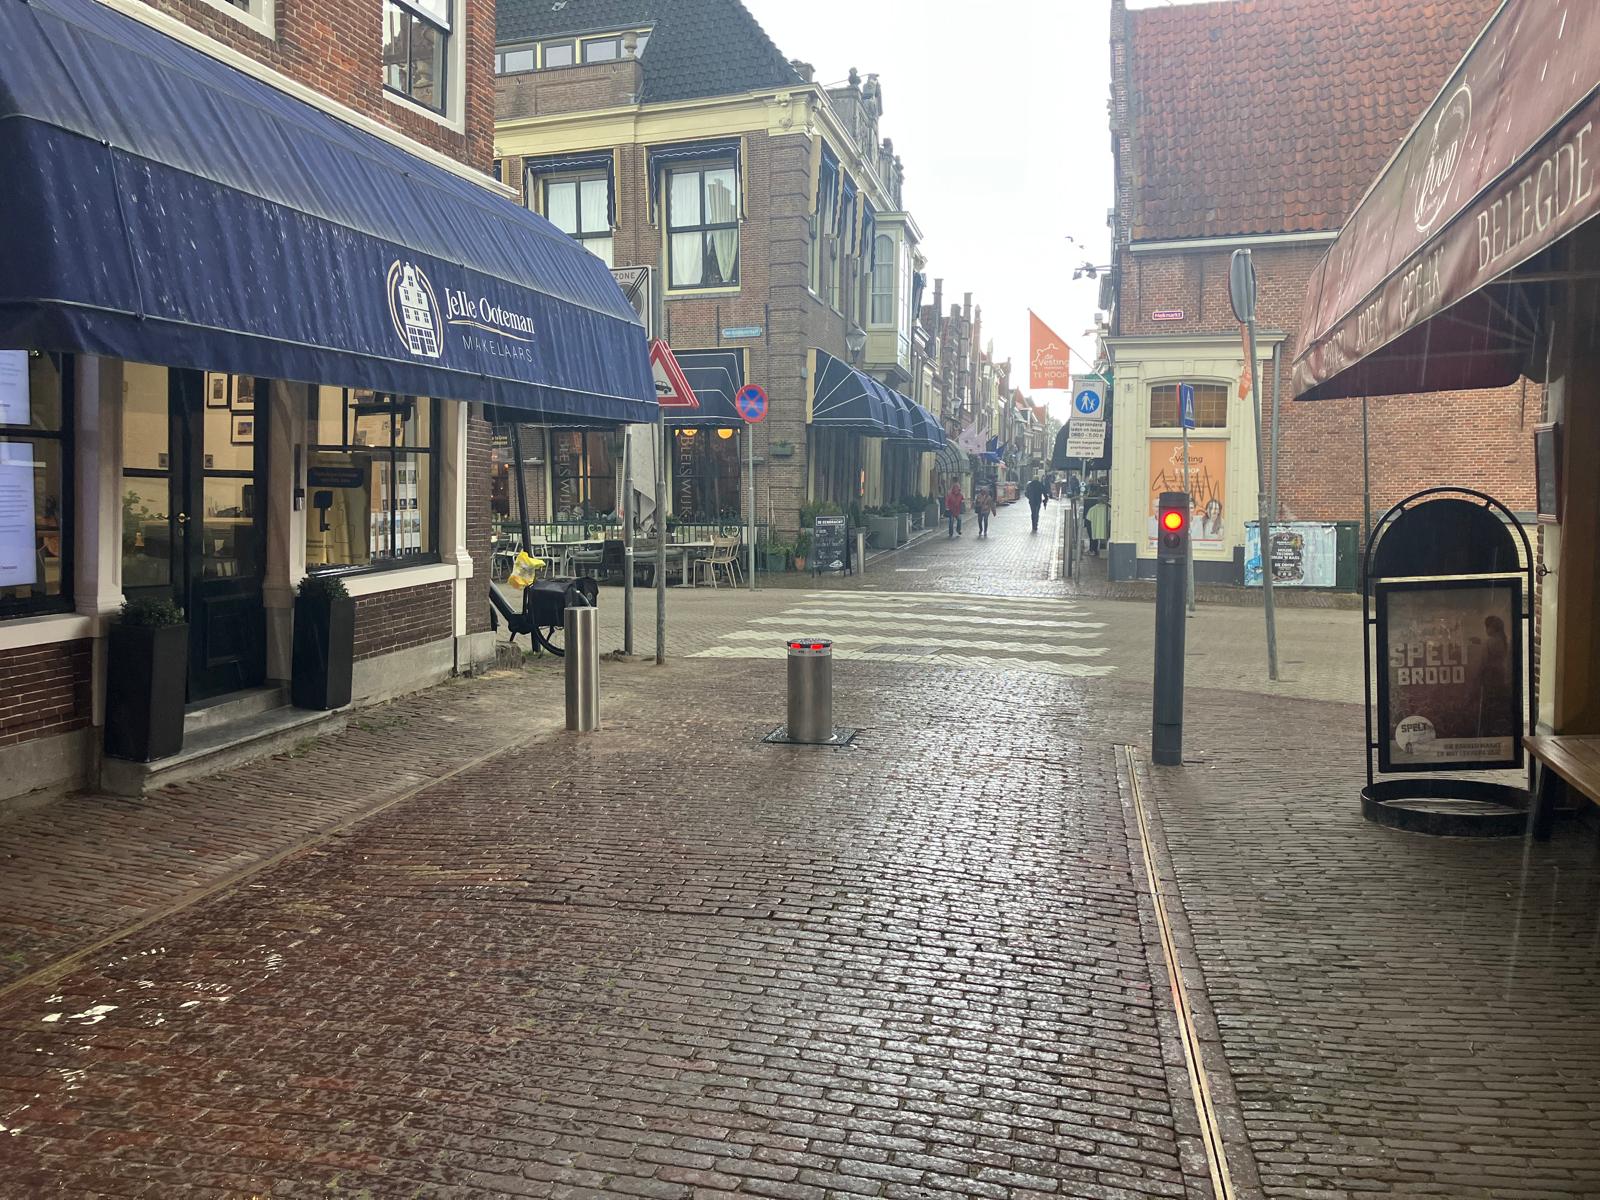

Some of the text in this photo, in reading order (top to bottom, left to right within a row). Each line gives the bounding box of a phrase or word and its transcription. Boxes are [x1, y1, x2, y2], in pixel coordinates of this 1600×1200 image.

[1477, 121, 1593, 272] BELEGDE
[613, 271, 636, 281] ZONE
[444, 287, 536, 334] Jelle Ooteman
[1356, 297, 1384, 352] KOEK
[462, 335, 533, 363] MAKELAARS
[1175, 456, 1203, 464] Veting
[1390, 640, 1471, 667] SPELT
[1397, 666, 1465, 686] BROOD
[1400, 721, 1428, 734] SPELT
